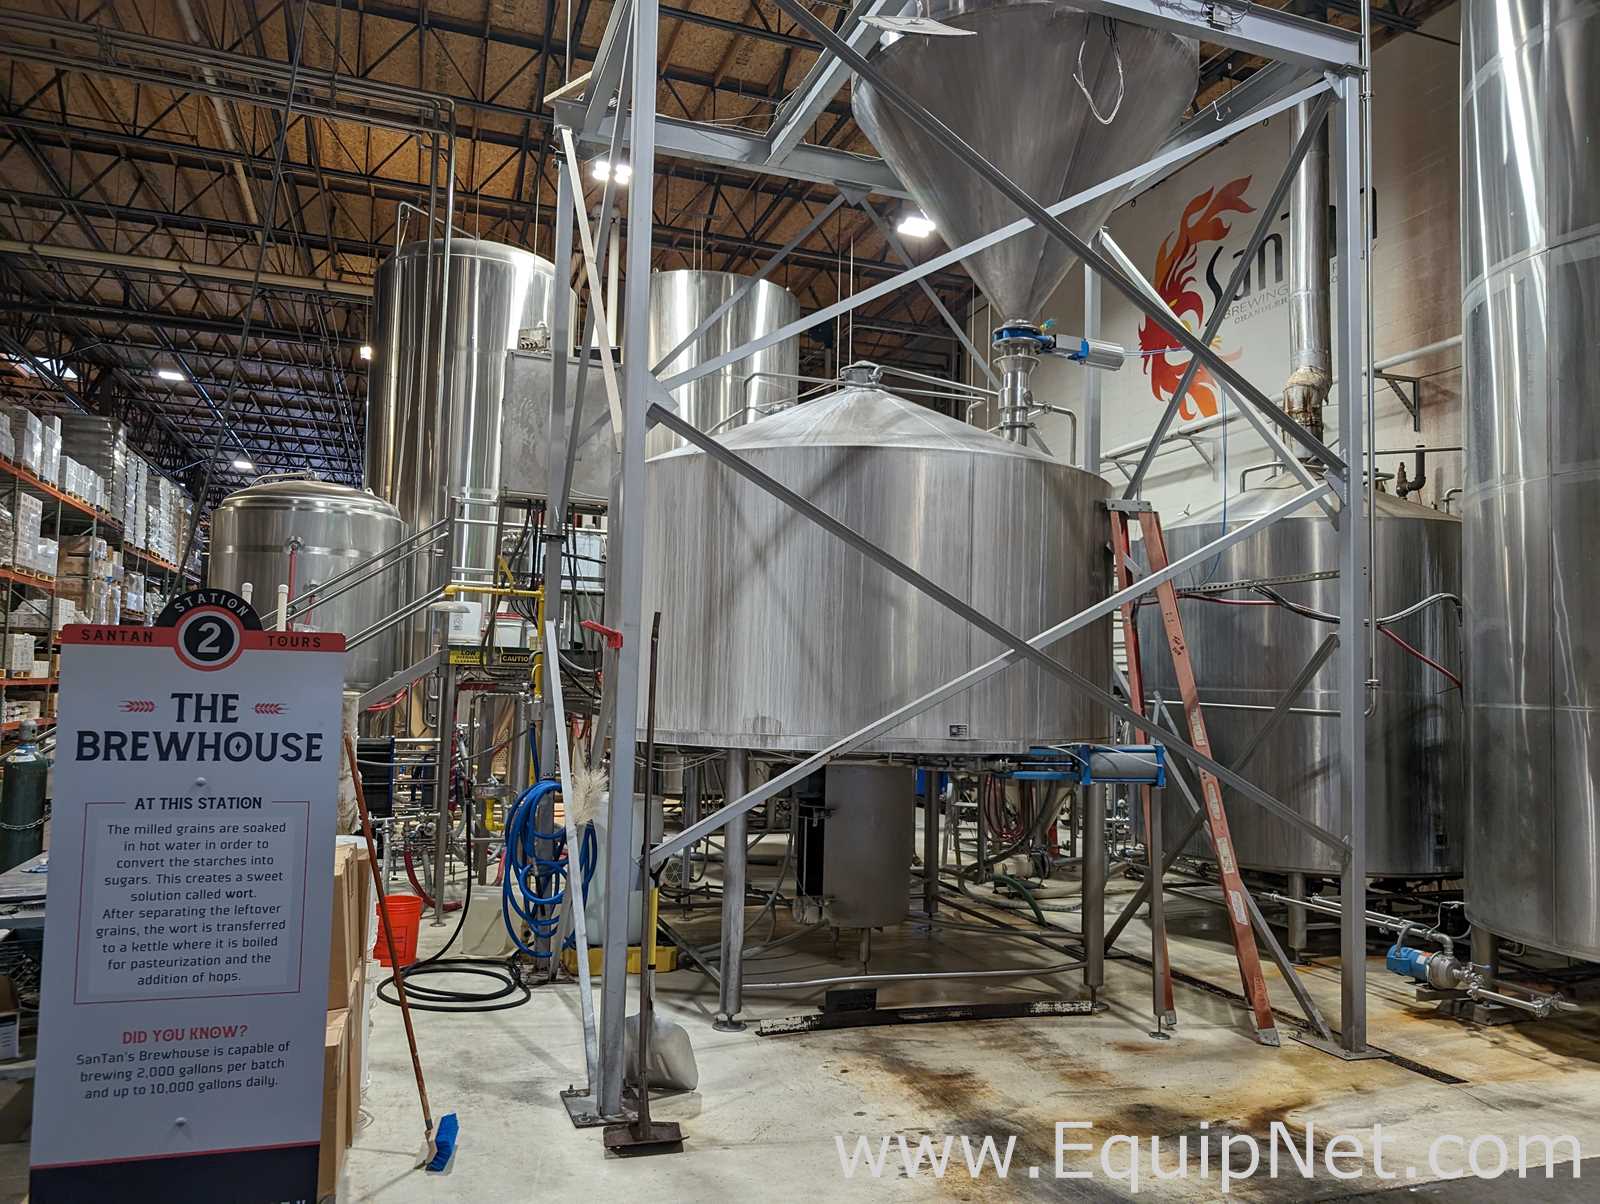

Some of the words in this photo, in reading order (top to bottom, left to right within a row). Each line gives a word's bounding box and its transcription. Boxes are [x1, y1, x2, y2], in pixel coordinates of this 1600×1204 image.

[174, 592, 249, 618] STATION
[82, 629, 153, 643] SANTAN
[268, 635, 321, 648] TOURS
[197, 622, 221, 653] 2
[171, 692, 240, 723] THE
[75, 730, 323, 762] BREWHOUSE
[134, 797, 155, 810] AT
[160, 797, 193, 810] THIS
[198, 797, 262, 809] STATION
[107, 824, 130, 835] The
[134, 823, 172, 835] milled
[176, 823, 215, 836] grains
[219, 824, 239, 833] are
[243, 822, 287, 833] soaked
[123, 841, 135, 852] in
[139, 840, 160, 851] hot
[164, 841, 200, 850] water
[205, 839, 216, 850] in
[220, 839, 252, 850] order
[257, 840, 269, 849] to
[116, 858, 165, 869] convert
[169, 856, 190, 867] the
[193, 856, 247, 867] starches
[251, 855, 274, 865] into
[104, 876, 151, 888] sugars.
[156, 873, 182, 885] This
[185, 873, 232, 884] creates
[235, 874, 243, 882] a
[247, 872, 283, 882] sweet
[130, 890, 181, 902] solution
[185, 889, 221, 900] called
[225, 889, 257, 899] wort.
[102, 909, 134, 920] After
[138, 906, 206, 920] separating
[210, 905, 231, 916] the
[234, 903, 281, 915] leftover
[95, 925, 140, 939] grains,
[144, 924, 164, 935] the
[168, 923, 198, 934] wort
[202, 923, 212, 933] is
[216, 919, 286, 932] transferred
[102, 943, 115, 953] to
[119, 944, 127, 953] a
[131, 940, 169, 953] kettle
[172, 939, 211, 951] where
[215, 938, 223, 949] it
[228, 938, 238, 948] is
[242, 936, 278, 947] boiled
[107, 959, 126, 970] for
[130, 955, 221, 971] pasteurization
[225, 954, 247, 965] and
[251, 953, 271, 964] the
[137, 973, 188, 986] addition
[192, 972, 205, 983] of
[208, 971, 241, 983] hops.
[122, 1031, 148, 1044] DID
[152, 1028, 185, 1042] YOU
[189, 1024, 249, 1040] KNOW?
[75, 1051, 135, 1065] SanTan's
[139, 1047, 210, 1062] Brewhouse
[213, 1045, 224, 1056] is
[227, 1042, 274, 1057] capable
[278, 1041, 291, 1052] of
[80, 1070, 132, 1083] brewing
[179, 1064, 223, 1078] gallons
[227, 1063, 247, 1076] per
[251, 1058, 285, 1071] batch
[85, 1087, 109, 1099] and
[113, 1087, 129, 1099] up
[133, 1084, 146, 1095] to
[198, 1078, 242, 1093] gallons
[246, 1075, 279, 1088] daily.
